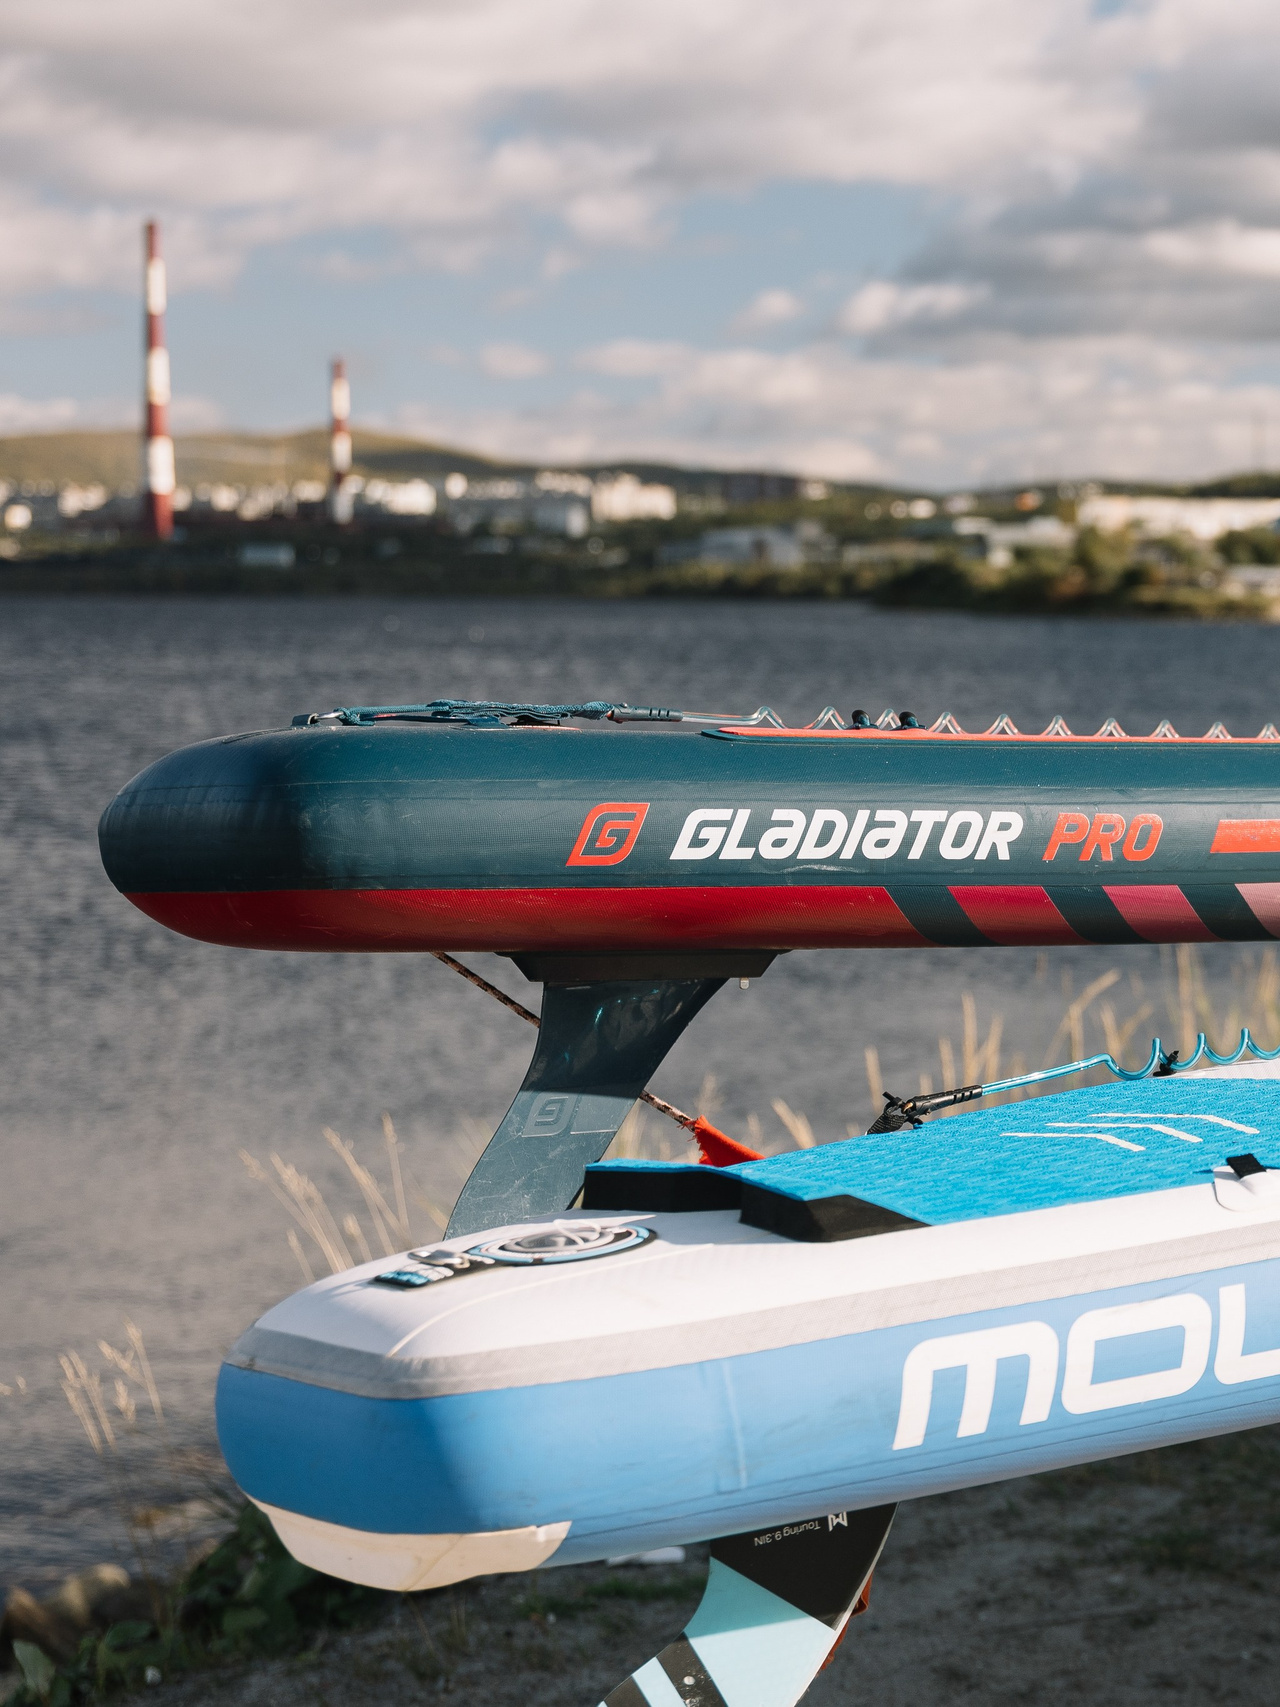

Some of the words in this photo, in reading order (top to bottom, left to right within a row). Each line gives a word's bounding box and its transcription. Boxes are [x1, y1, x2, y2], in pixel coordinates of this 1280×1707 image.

[1042, 811, 1164, 863] PRO
[783, 1520, 821, 1537] Touring
[754, 1530, 783, 1546] 9.3IN
